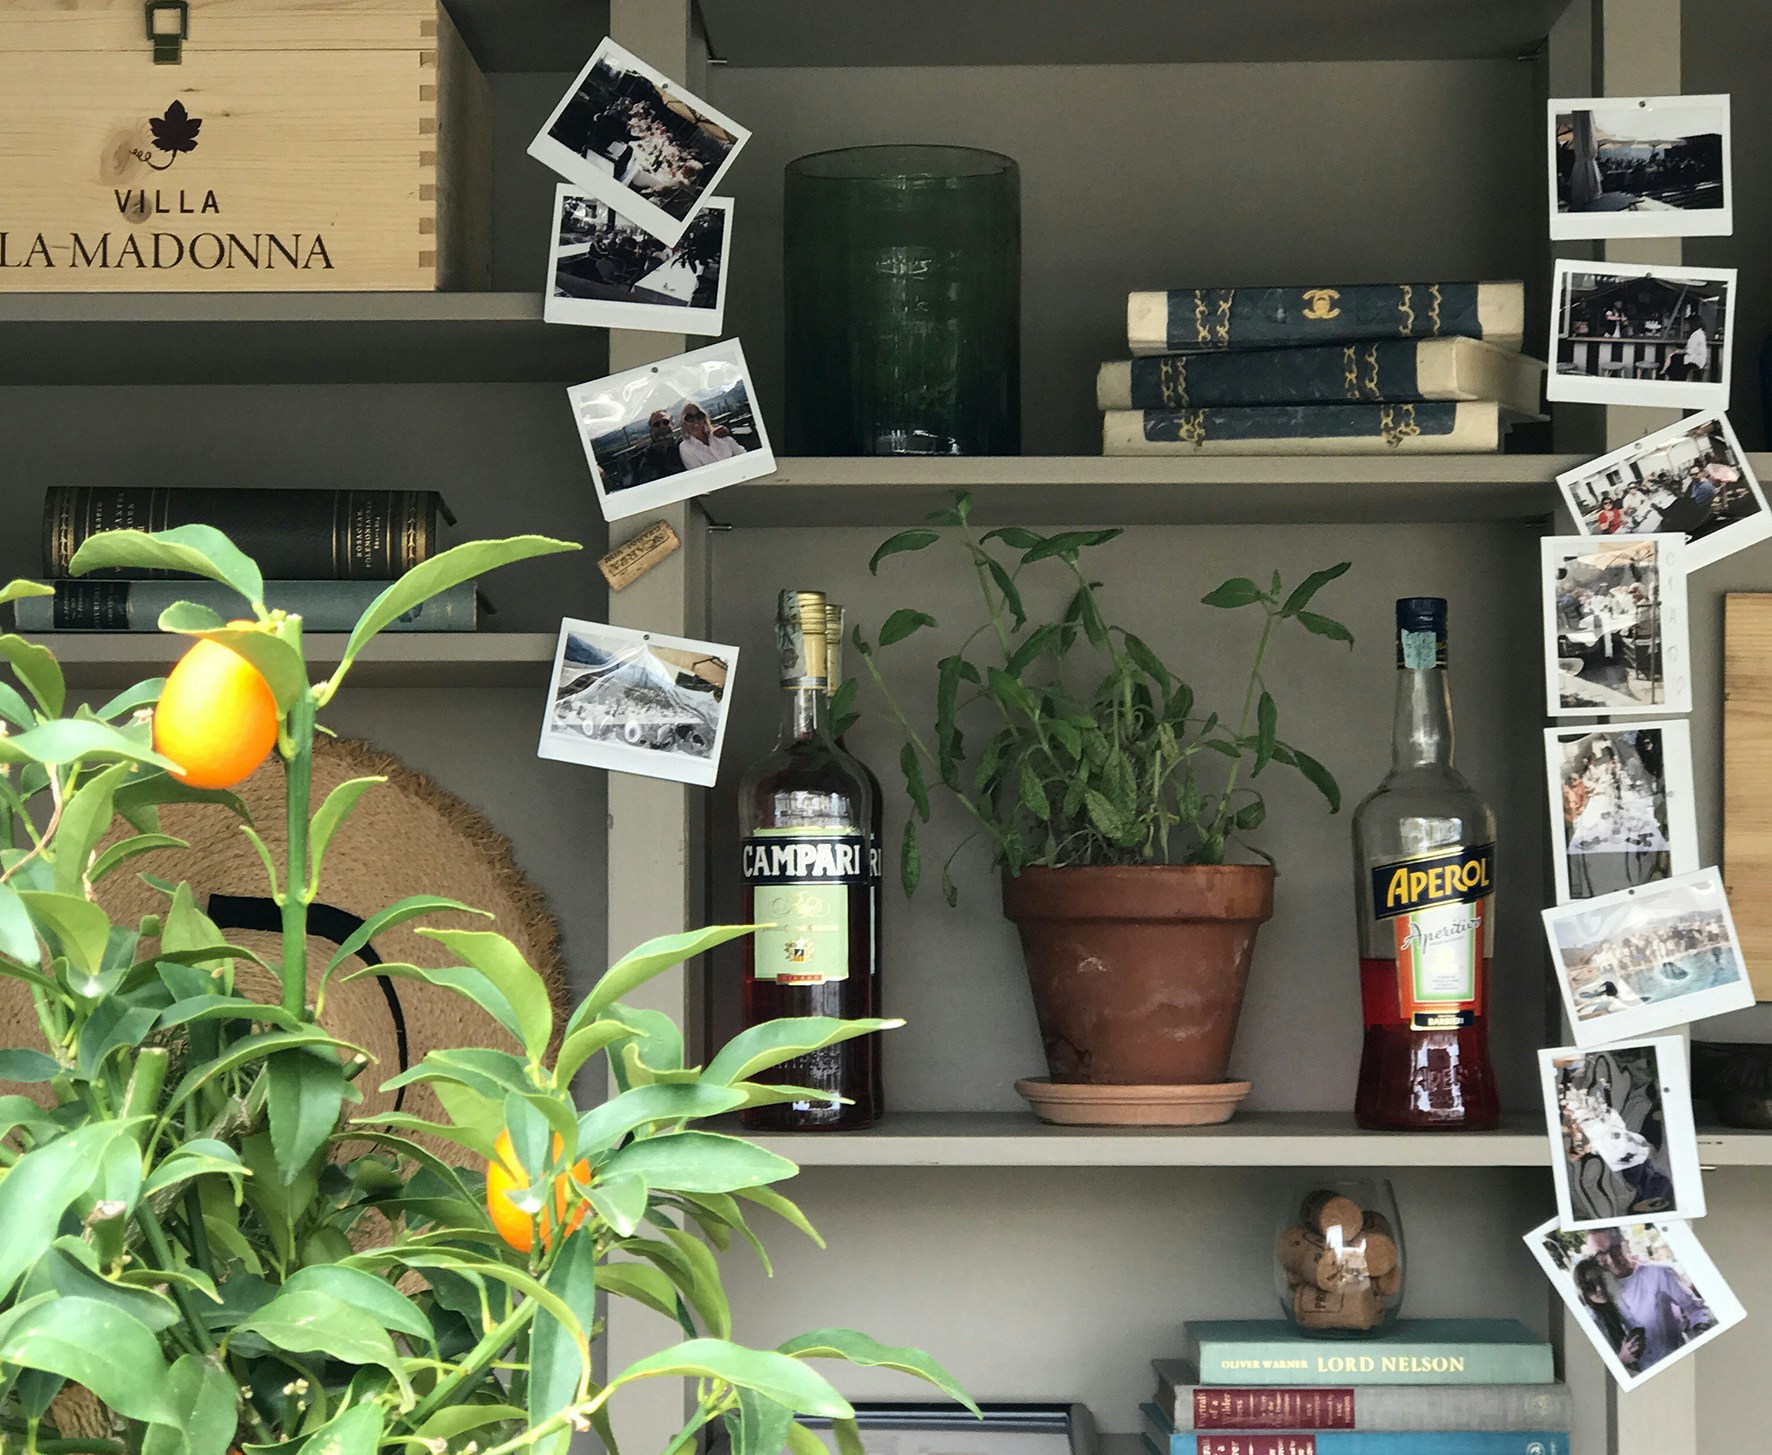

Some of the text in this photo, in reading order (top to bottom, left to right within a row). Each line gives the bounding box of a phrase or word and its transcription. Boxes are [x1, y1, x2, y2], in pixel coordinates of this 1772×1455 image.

[115, 189, 219, 214] VILLA
[0, 232, 335, 269] LA MADONNA
[743, 843, 861, 877] CAMPARI
[1387, 858, 1489, 908] APEROL
[1221, 1356, 1465, 1373] OLIVER WARNER LORD NELSON
